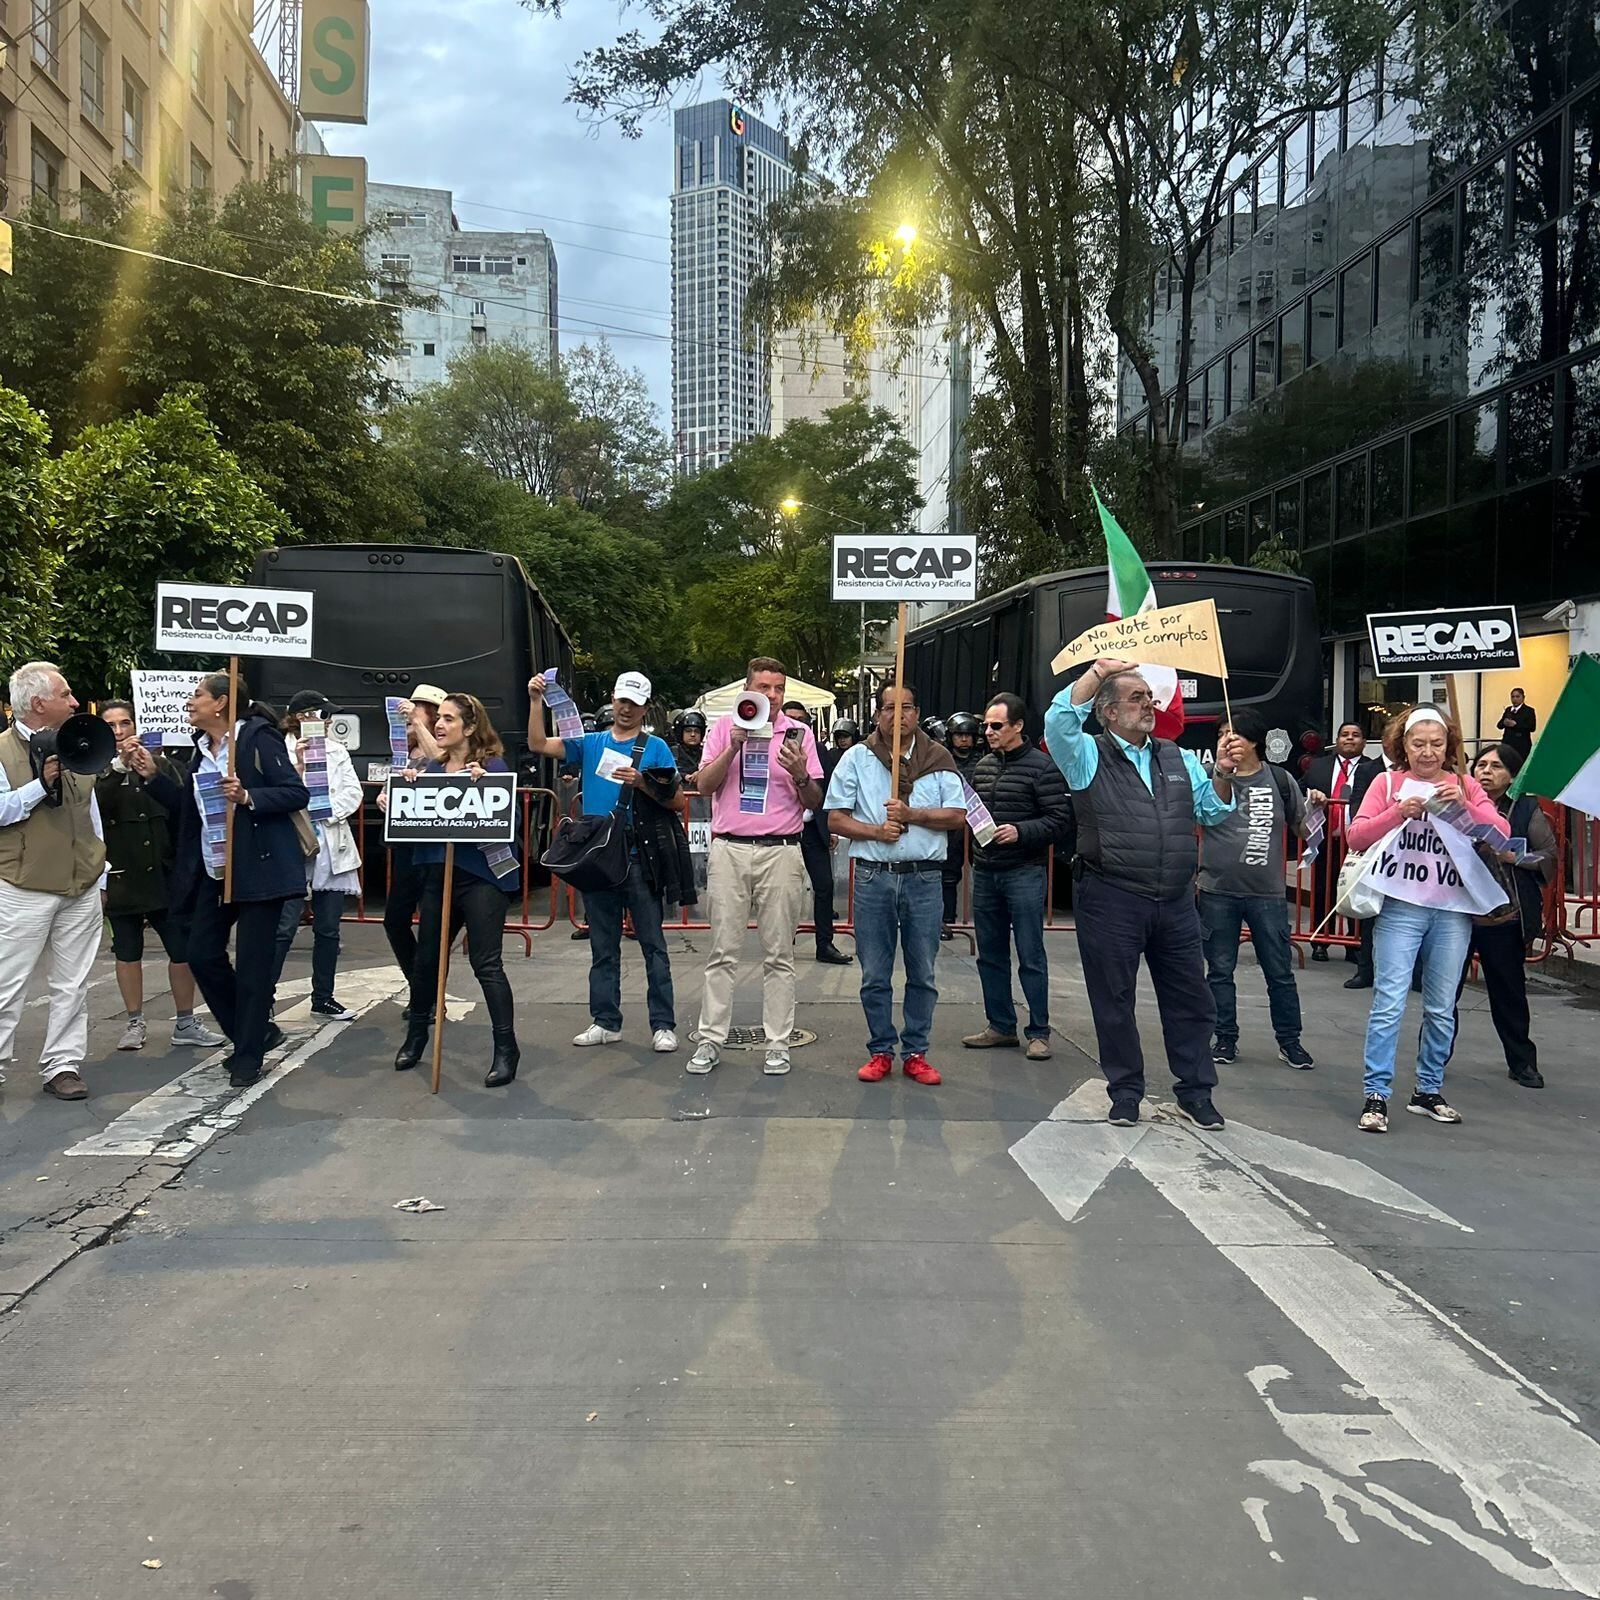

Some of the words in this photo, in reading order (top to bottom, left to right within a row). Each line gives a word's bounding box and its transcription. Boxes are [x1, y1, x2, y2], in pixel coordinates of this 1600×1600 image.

[838, 547, 972, 579] RECAP
[162, 596, 308, 634] RECAP
[162, 629, 213, 640] Resistencia
[215, 632, 233, 641] Civil
[235, 634, 263, 642] Activa
[1088, 630, 1107, 642] No
[1160, 614, 1182, 629] por
[1143, 624, 1208, 646] corruptos
[1374, 619, 1511, 655] RECAP
[1380, 653, 1425, 663] Resistencia
[1426, 652, 1444, 661] Civil
[1446, 651, 1472, 660] Activa
[1473, 652, 1479, 660] y
[391, 786, 510, 819] RECAP
[391, 819, 432, 827] Resistencia
[433, 819, 448, 827] Civil
[449, 819, 472, 827] Activa
[473, 820, 479, 829] y
[1403, 862, 1429, 882] no
